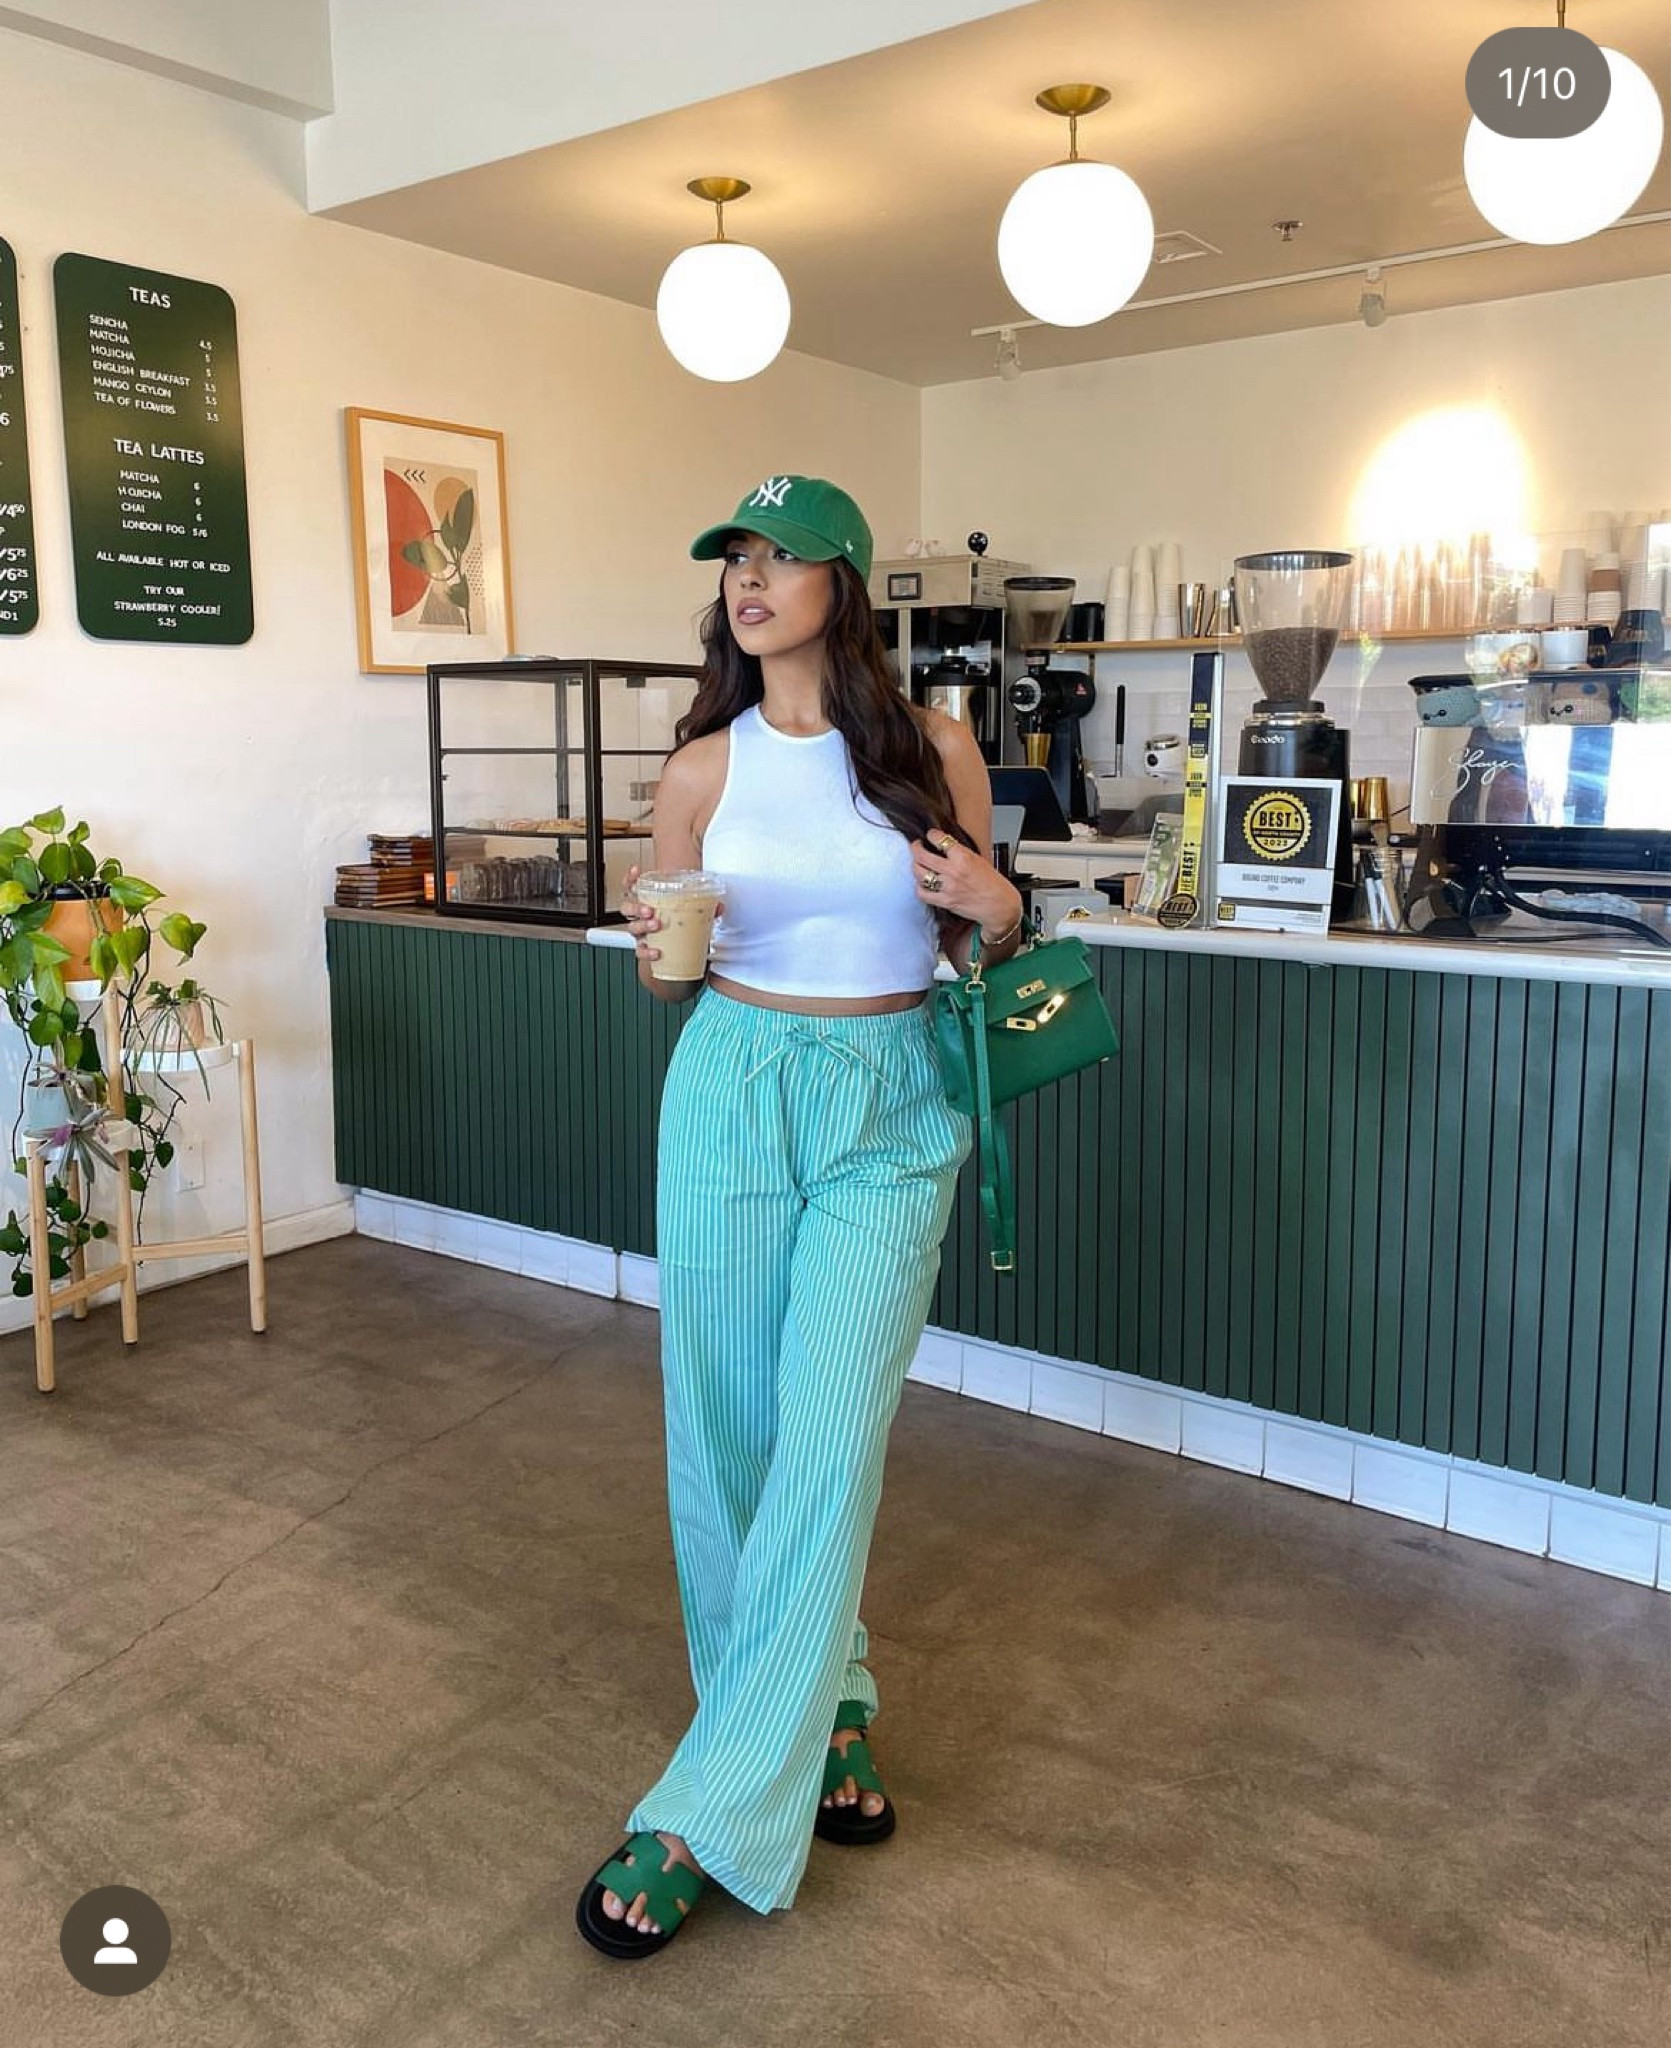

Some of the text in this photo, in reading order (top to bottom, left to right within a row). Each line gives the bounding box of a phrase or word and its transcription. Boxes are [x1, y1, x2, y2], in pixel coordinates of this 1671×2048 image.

[128, 286, 171, 308] TEAS
[89, 314, 128, 330] SENCHA
[89, 328, 130, 344] MATCHA
[91, 344, 136, 361] HOJICHA
[93, 360, 135, 375] ENGLISH
[140, 369, 190, 386] BREAKFAST
[93, 376, 130, 391] MANGO
[135, 383, 171, 398] CEYLON
[94, 391, 114, 404] TEA
[117, 396, 131, 406] OF
[135, 399, 176, 414] FLOWERS
[114, 438, 204, 465] TEA LATTES
[120, 470, 160, 484] MATCHA
[749, 477, 792, 507] NY
[121, 502, 145, 513] CHAI
[122, 519, 162, 532] LONDON
[166, 524, 185, 535] FOG
[96, 551, 231, 573] ALL AVAILABLE HOT OR ICED
[143, 585, 184, 596] TRY OUR
[114, 600, 221, 616] STRAWBERRY COOLER!
[157, 618, 177, 628] 5.25
[1259, 810, 1292, 828] BEST
